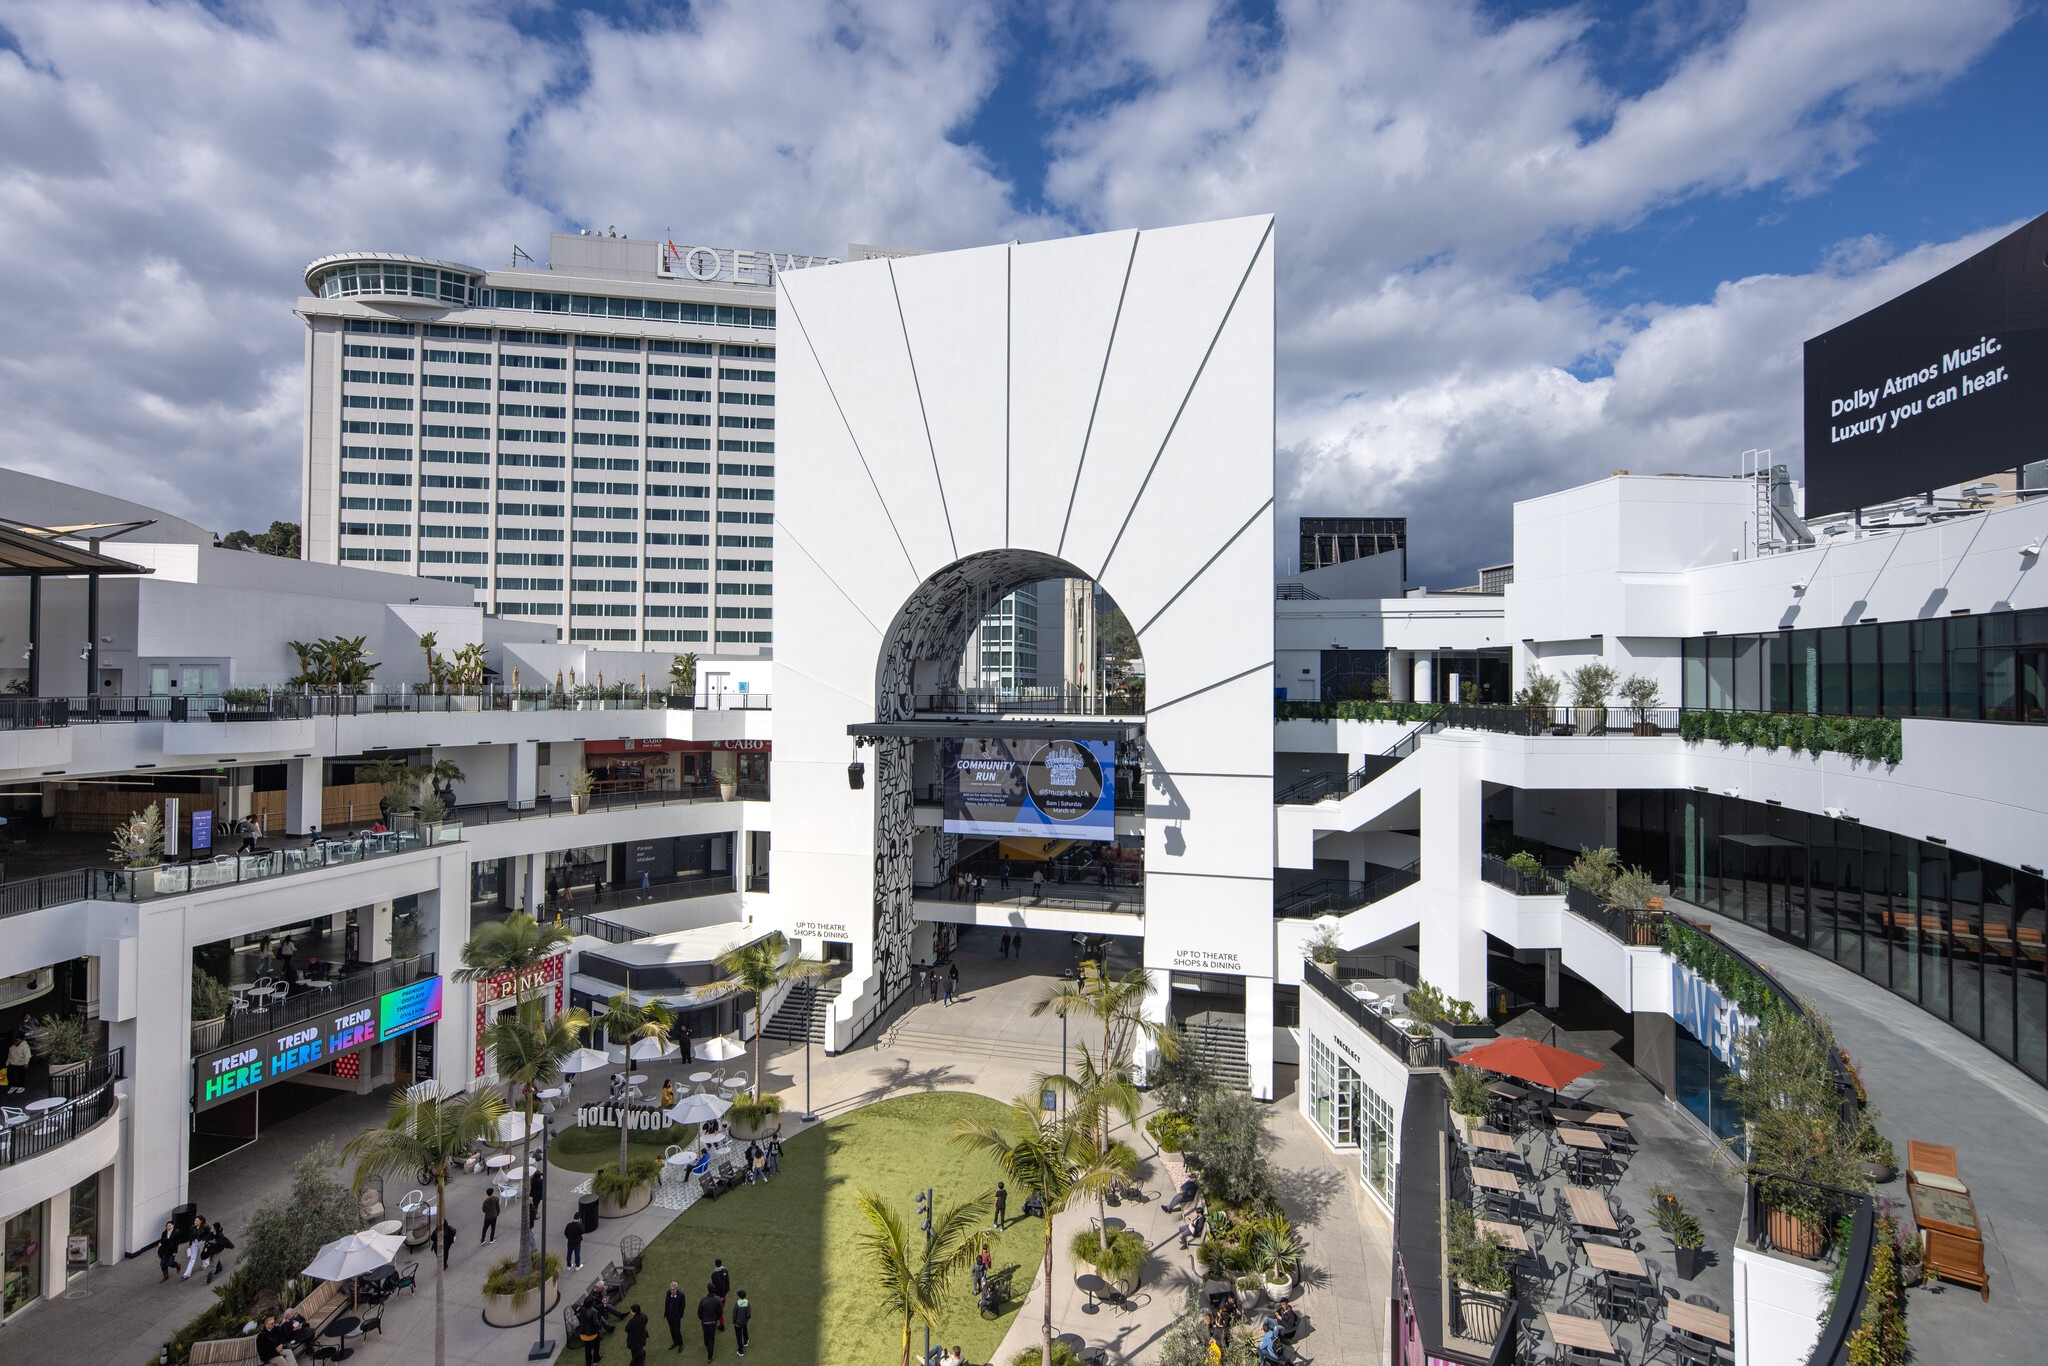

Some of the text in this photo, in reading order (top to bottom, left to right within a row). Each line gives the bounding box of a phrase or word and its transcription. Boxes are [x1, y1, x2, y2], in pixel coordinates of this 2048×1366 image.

[1831, 336, 2002, 417] Dolby Atmos Music.
[1831, 366, 2008, 443] Luxury you can hear.
[724, 739, 764, 749] CABO
[957, 760, 1016, 771] COMMUNITY
[976, 772, 997, 781] RUN
[793, 929, 816, 937] SHOPS
[823, 931, 849, 939] DINING
[817, 923, 846, 931] THEATRE
[1173, 958, 1201, 967] SHOPS
[1210, 961, 1241, 970] DINING
[1202, 952, 1238, 961] THEATRE
[501, 970, 545, 998] PINK
[335, 1008, 372, 1031] TREND
[1672, 962, 1725, 1062] DAVE
[277, 1027, 319, 1051] TREND
[329, 1020, 375, 1055] HERE
[212, 1048, 258, 1075] TREND
[271, 1039, 323, 1077] HERE
[205, 1061, 263, 1101] HERE
[577, 1106, 673, 1131] HOLLYWOOD
